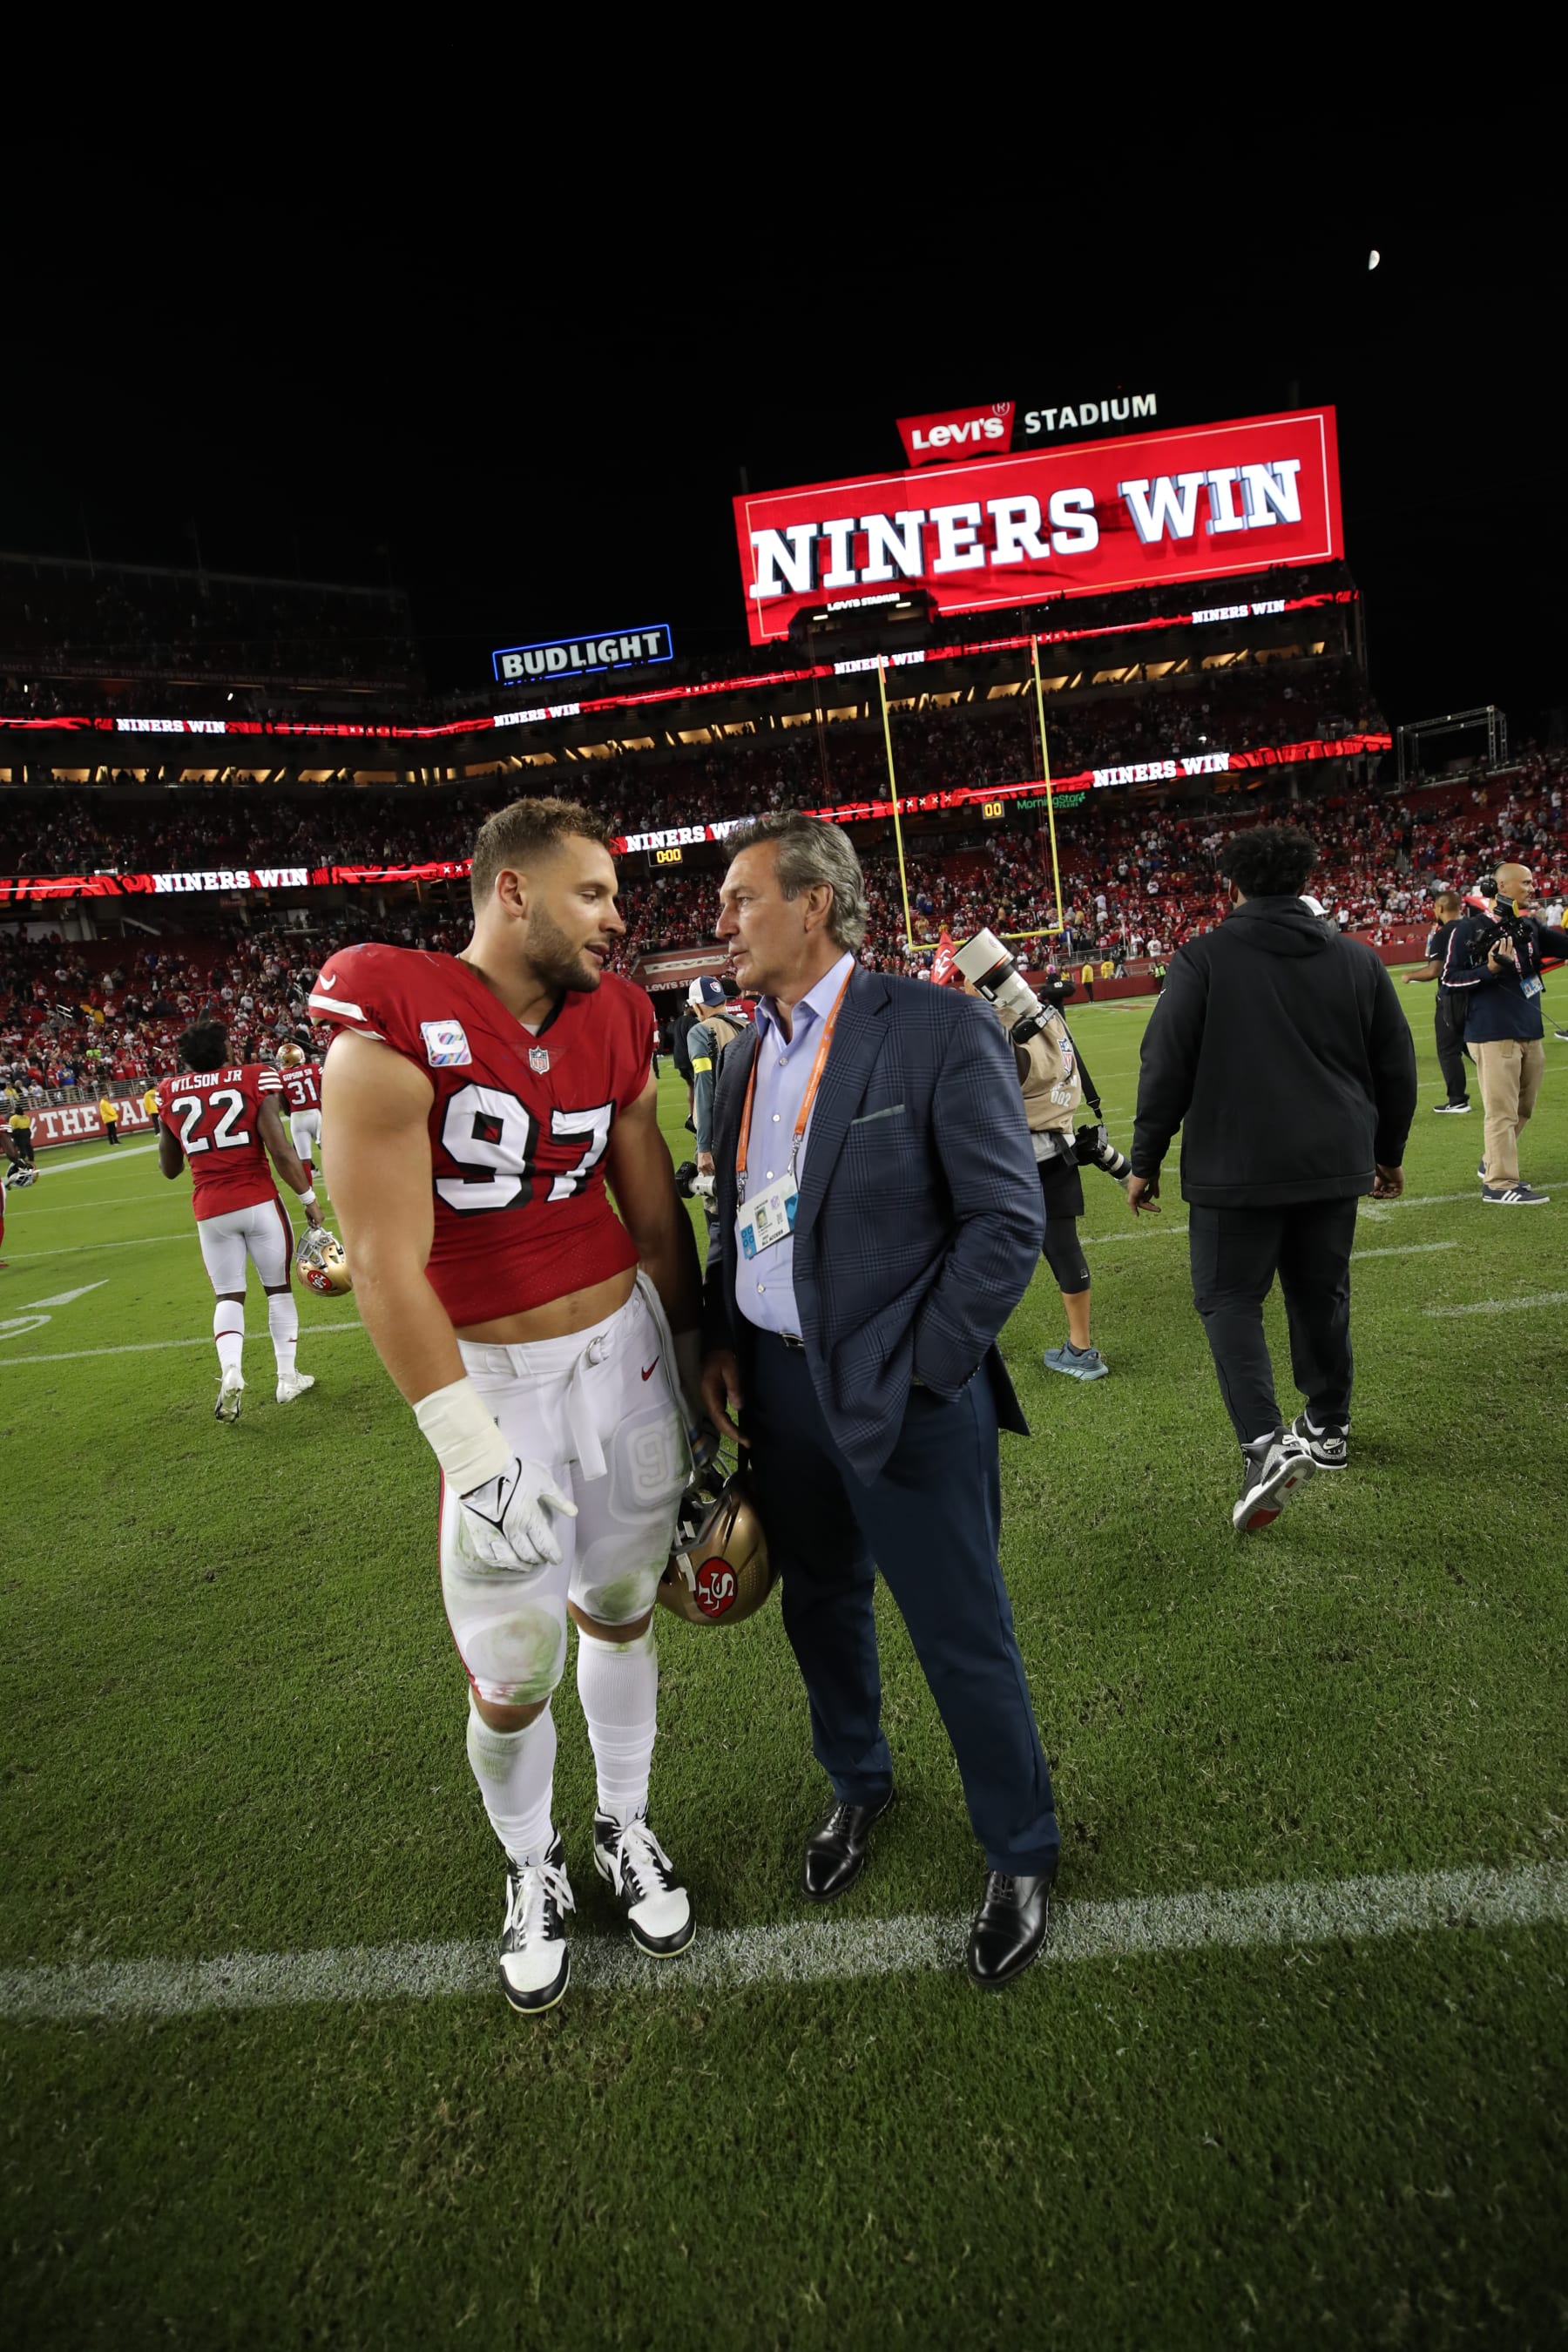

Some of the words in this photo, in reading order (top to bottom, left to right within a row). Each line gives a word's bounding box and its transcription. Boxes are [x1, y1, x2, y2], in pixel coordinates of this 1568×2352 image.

[1024, 394, 1157, 434] STADIUM
[749, 486, 1099, 599] NINERS
[1117, 458, 1302, 544] WIN
[1192, 605, 1248, 624] NINERS
[1251, 599, 1285, 615] WIN
[834, 656, 889, 675] NINERS
[891, 650, 925, 666] WIN
[116, 719, 185, 733] NINERS
[187, 720, 226, 733] WIN
[494, 708, 547, 727] NINERS
[549, 702, 580, 717] WIN
[1093, 760, 1177, 788] NINERS
[1180, 753, 1230, 776] WIN
[984, 803, 1002, 817] 00
[625, 825, 706, 853] NINERS
[657, 848, 681, 863] 0:00
[152, 871, 251, 893] NINERS
[254, 868, 308, 888] WIN
[172, 1073, 220, 1094] WILSON
[223, 1070, 243, 1083] JR
[287, 1078, 318, 1105] 31
[38, 1105, 100, 1139] THE
[171, 1089, 253, 1155] 22
[436, 1082, 615, 1213] 97
